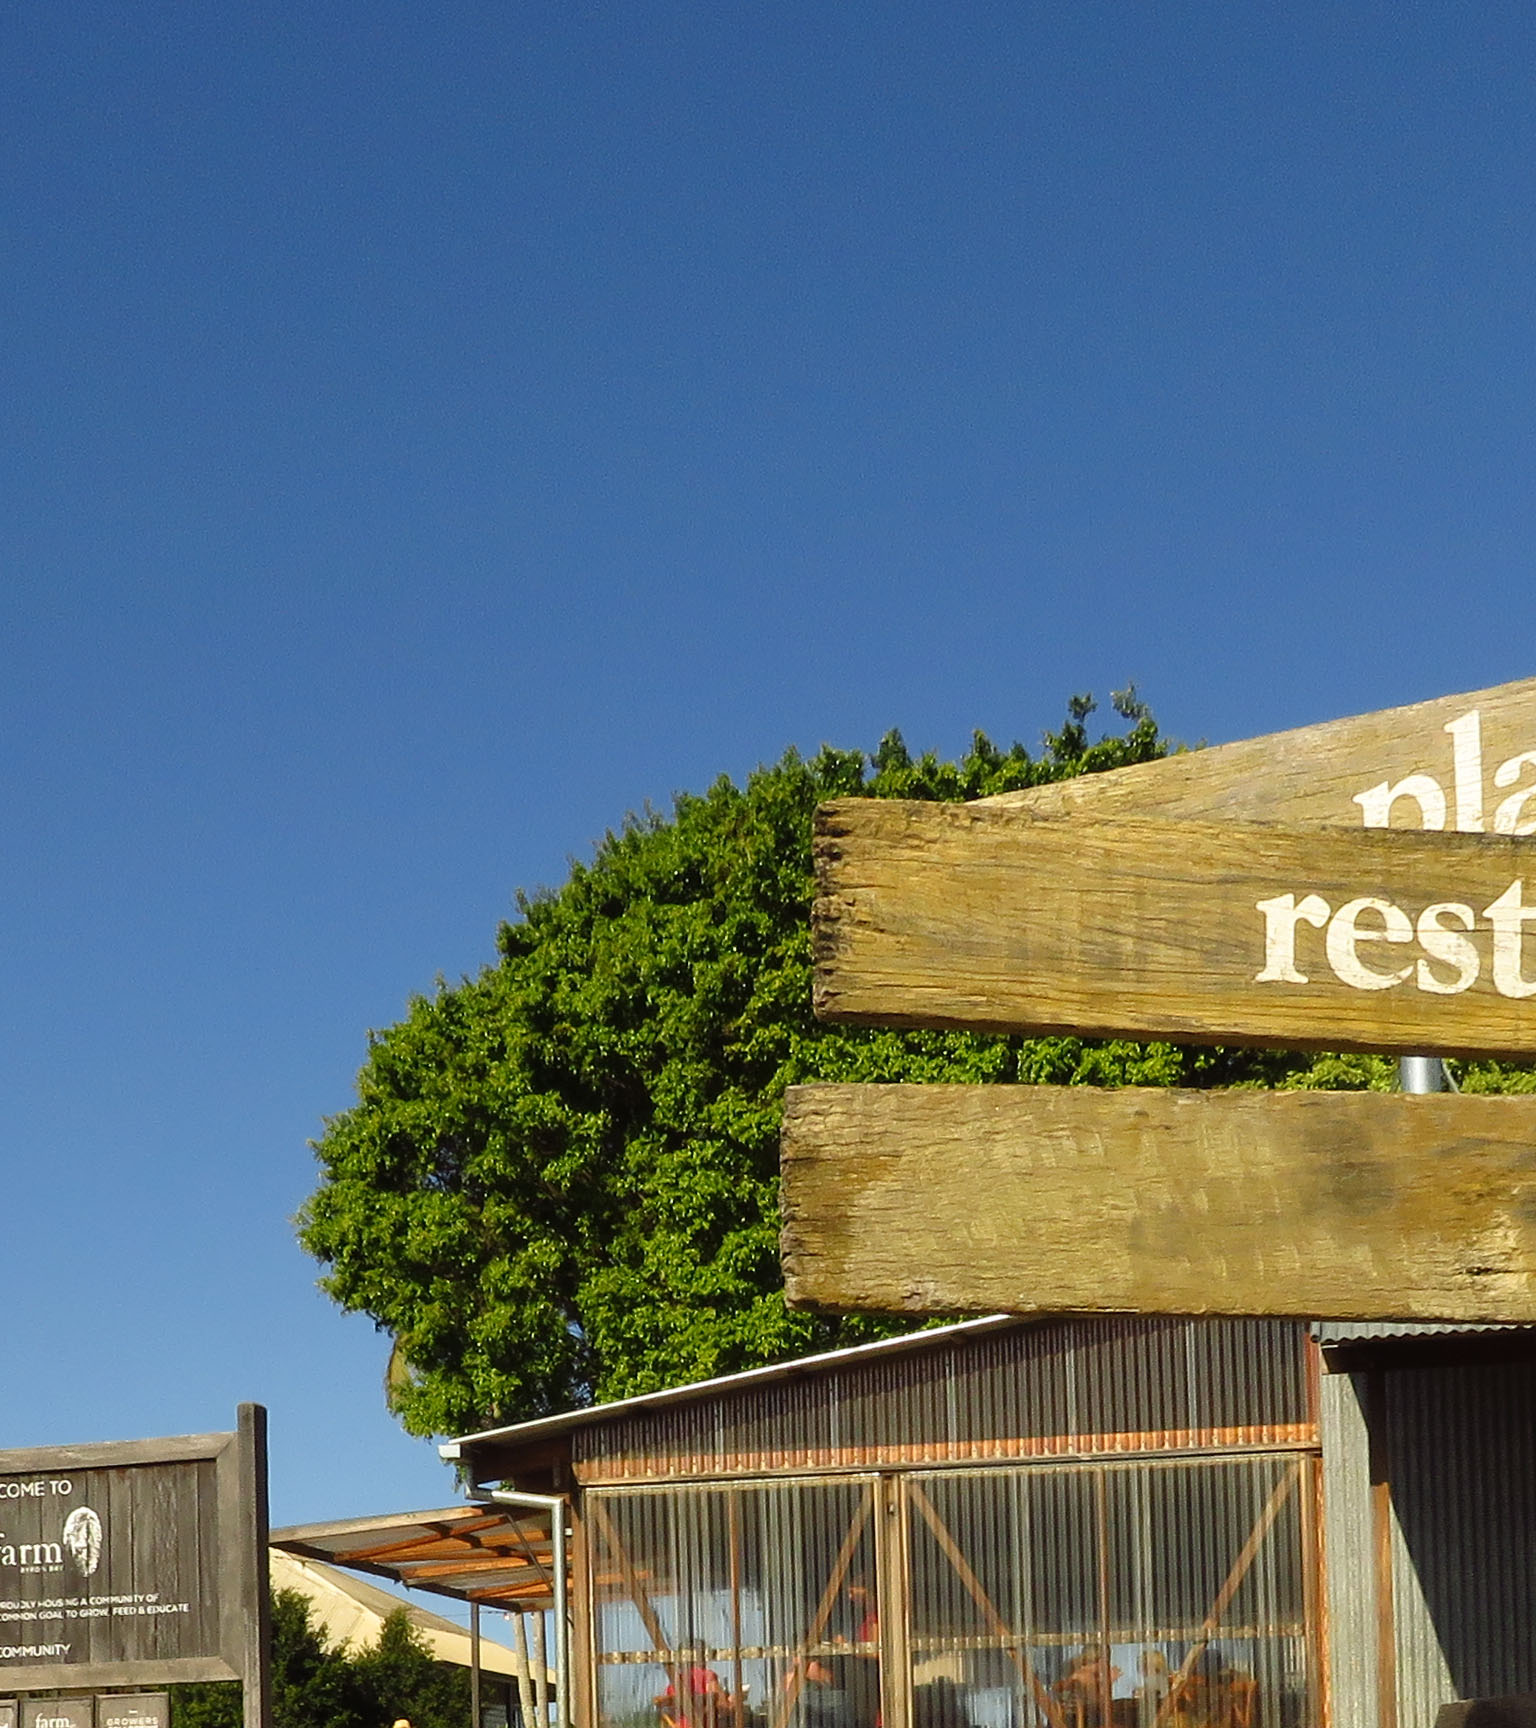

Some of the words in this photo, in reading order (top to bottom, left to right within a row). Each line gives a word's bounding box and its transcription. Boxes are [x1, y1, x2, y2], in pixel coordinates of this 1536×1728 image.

[50, 1480, 73, 1495] TO
[80, 1598, 88, 1606] A
[89, 1594, 145, 1605] COMMUNITY
[146, 1593, 160, 1602] OF
[39, 1610, 63, 1620] GOAL
[65, 1609, 78, 1618] TO
[112, 1606, 136, 1616] FEED
[146, 1603, 189, 1614] EDUCATE
[35, 1712, 70, 1728] farm
[106, 1717, 159, 1727] GROWERS
